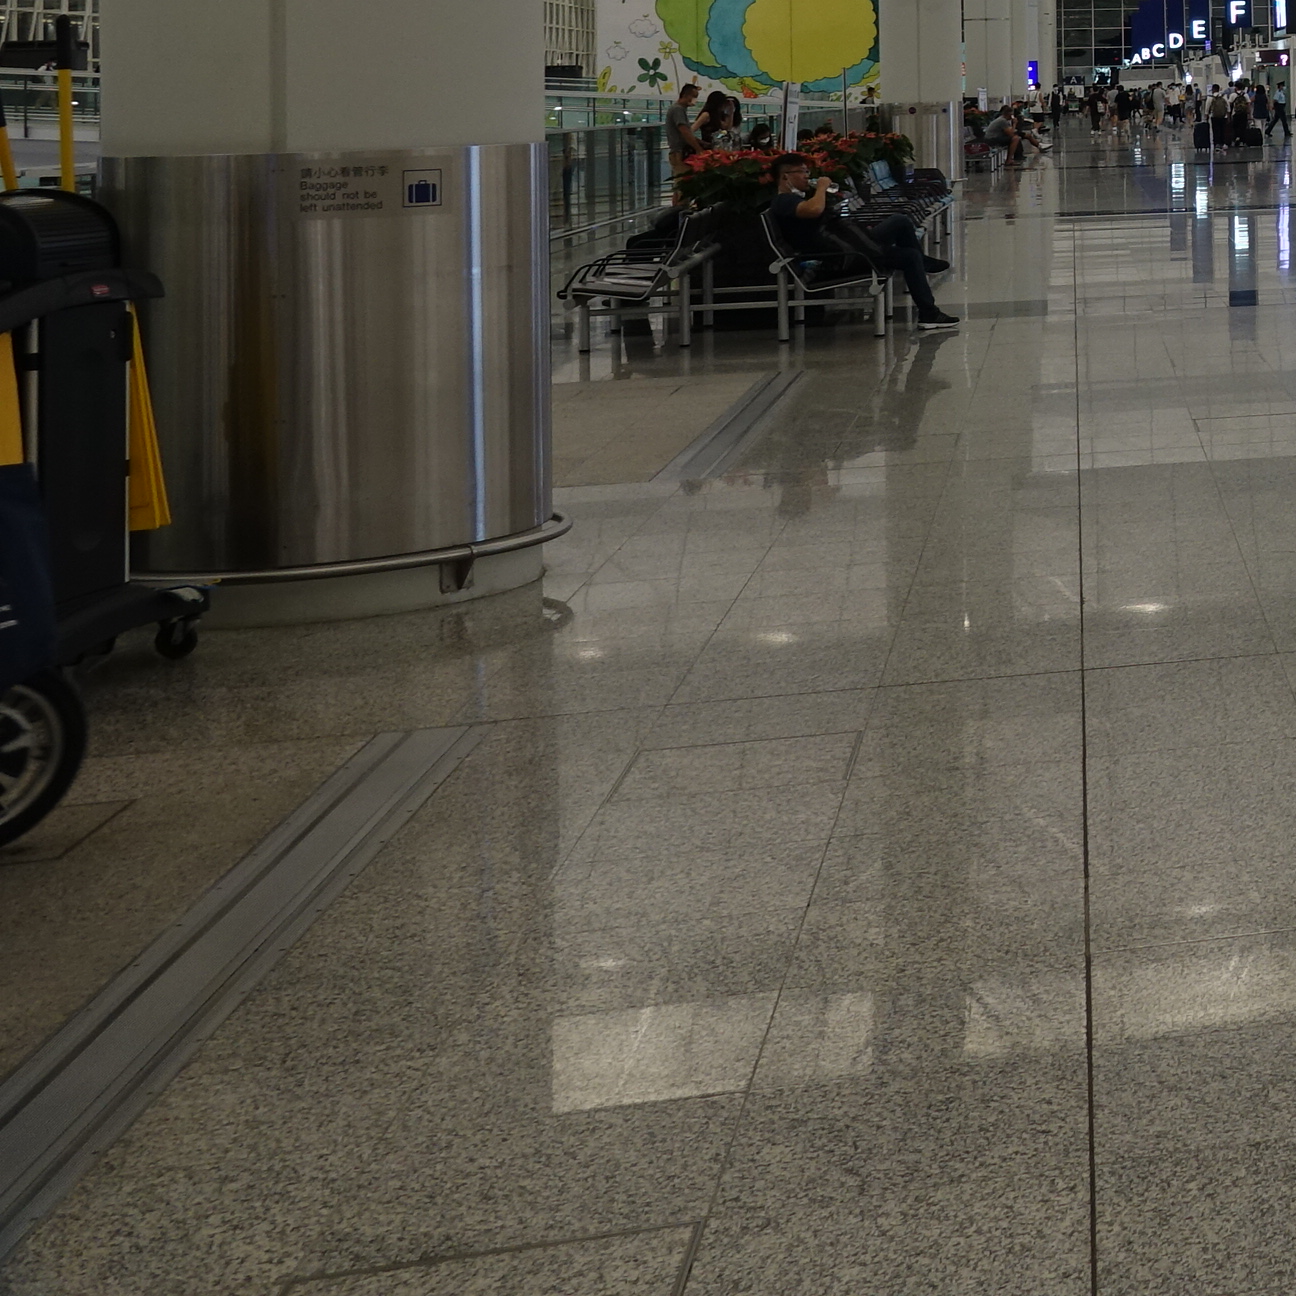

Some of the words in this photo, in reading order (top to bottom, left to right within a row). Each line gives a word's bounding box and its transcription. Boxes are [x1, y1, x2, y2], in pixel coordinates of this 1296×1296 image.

[1230, 0, 1246, 24] F
[1192, 19, 1206, 38] E
[1168, 32, 1184, 48] D
[1141, 47, 1151, 60] B
[1151, 43, 1165, 57] C
[300, 181, 348, 192] Baggage
[300, 191, 337, 202] should
[342, 190, 359, 200] not
[363, 190, 378, 199] be
[299, 202, 317, 213] left
[322, 200, 383, 212] unattended
